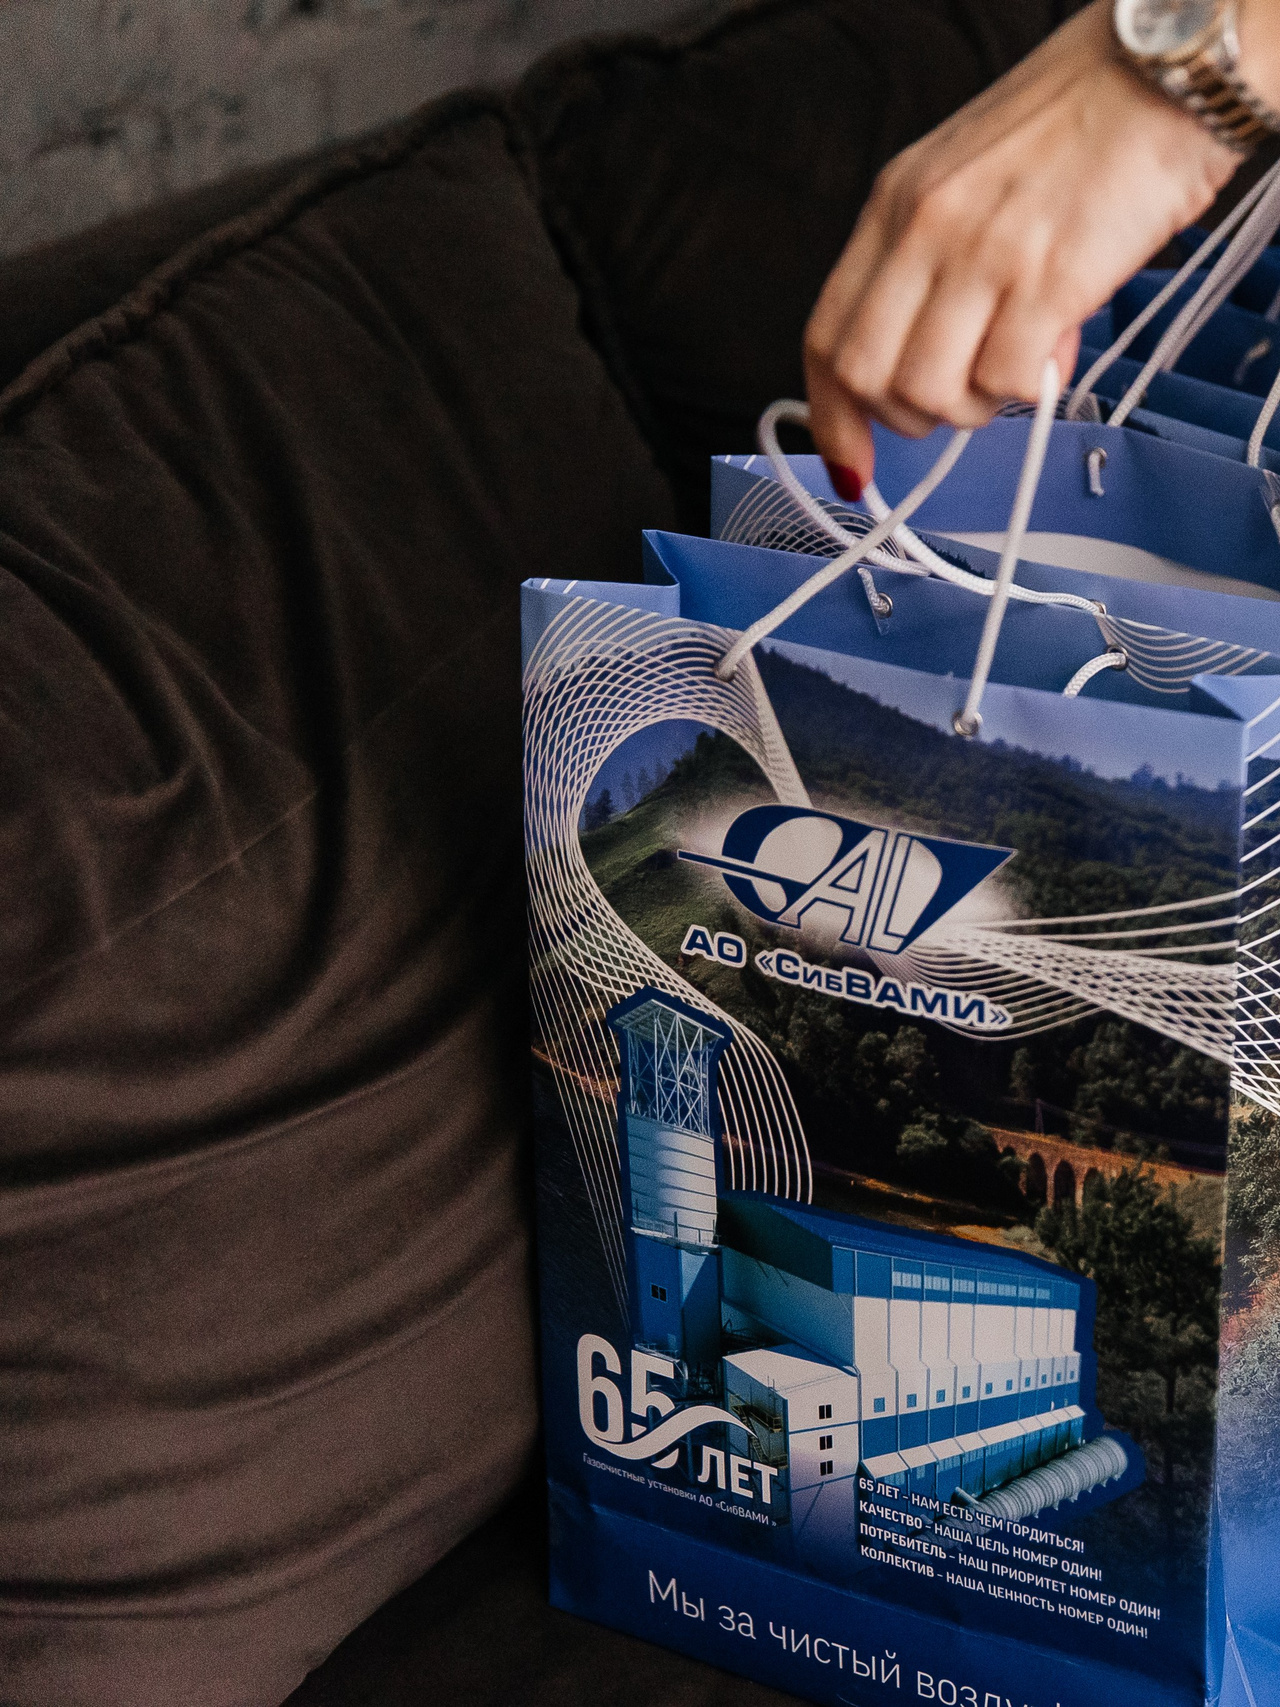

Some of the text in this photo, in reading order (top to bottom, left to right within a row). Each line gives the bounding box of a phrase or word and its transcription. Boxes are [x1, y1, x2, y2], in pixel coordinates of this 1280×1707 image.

[682, 925, 746, 968] АО
[577, 1334, 681, 1469] 65
[583, 1452, 646, 1484] Газоочистные
[647, 1478, 697, 1502] установки
[698, 1494, 713, 1507] АО
[698, 1445, 778, 1504] ЛЕТ
[859, 1477, 875, 1493] 65
[876, 1483, 900, 1501] ЛЕТ
[911, 1493, 940, 1512] НАМ
[943, 1503, 973, 1522] ЕСТЬ
[975, 1511, 1003, 1531] ЧЕМ
[1006, 1521, 1085, 1553] ГОРДИТЬСЯ!
[859, 1500, 923, 1529] КАЧЕСТВО
[934, 1522, 973, 1545] НАША
[975, 1535, 1010, 1556] ЦЕЛЬ
[1012, 1546, 1059, 1568] НОМЕР
[1061, 1559, 1102, 1582] ОДИН!
[860, 1523, 947, 1559] ПОТРЕБИТЕЛЬ
[958, 1553, 988, 1572] НАШ
[991, 1562, 1067, 1594] ПРИОРИТЕТ
[1069, 1584, 1116, 1607] НОМЕР
[1119, 1598, 1161, 1620] ОДИН!
[648, 1569, 705, 1622] Мы
[718, 1605, 757, 1640] за
[769, 1621, 901, 1689] чистый
[860, 1545, 934, 1578] КОЛЛЕКТИВ
[946, 1571, 985, 1593] НАША
[988, 1584, 1055, 1612] ЦЕННОСТЬ
[1058, 1604, 1104, 1625] НОМЕР
[1107, 1617, 1148, 1640] ОДИН!
